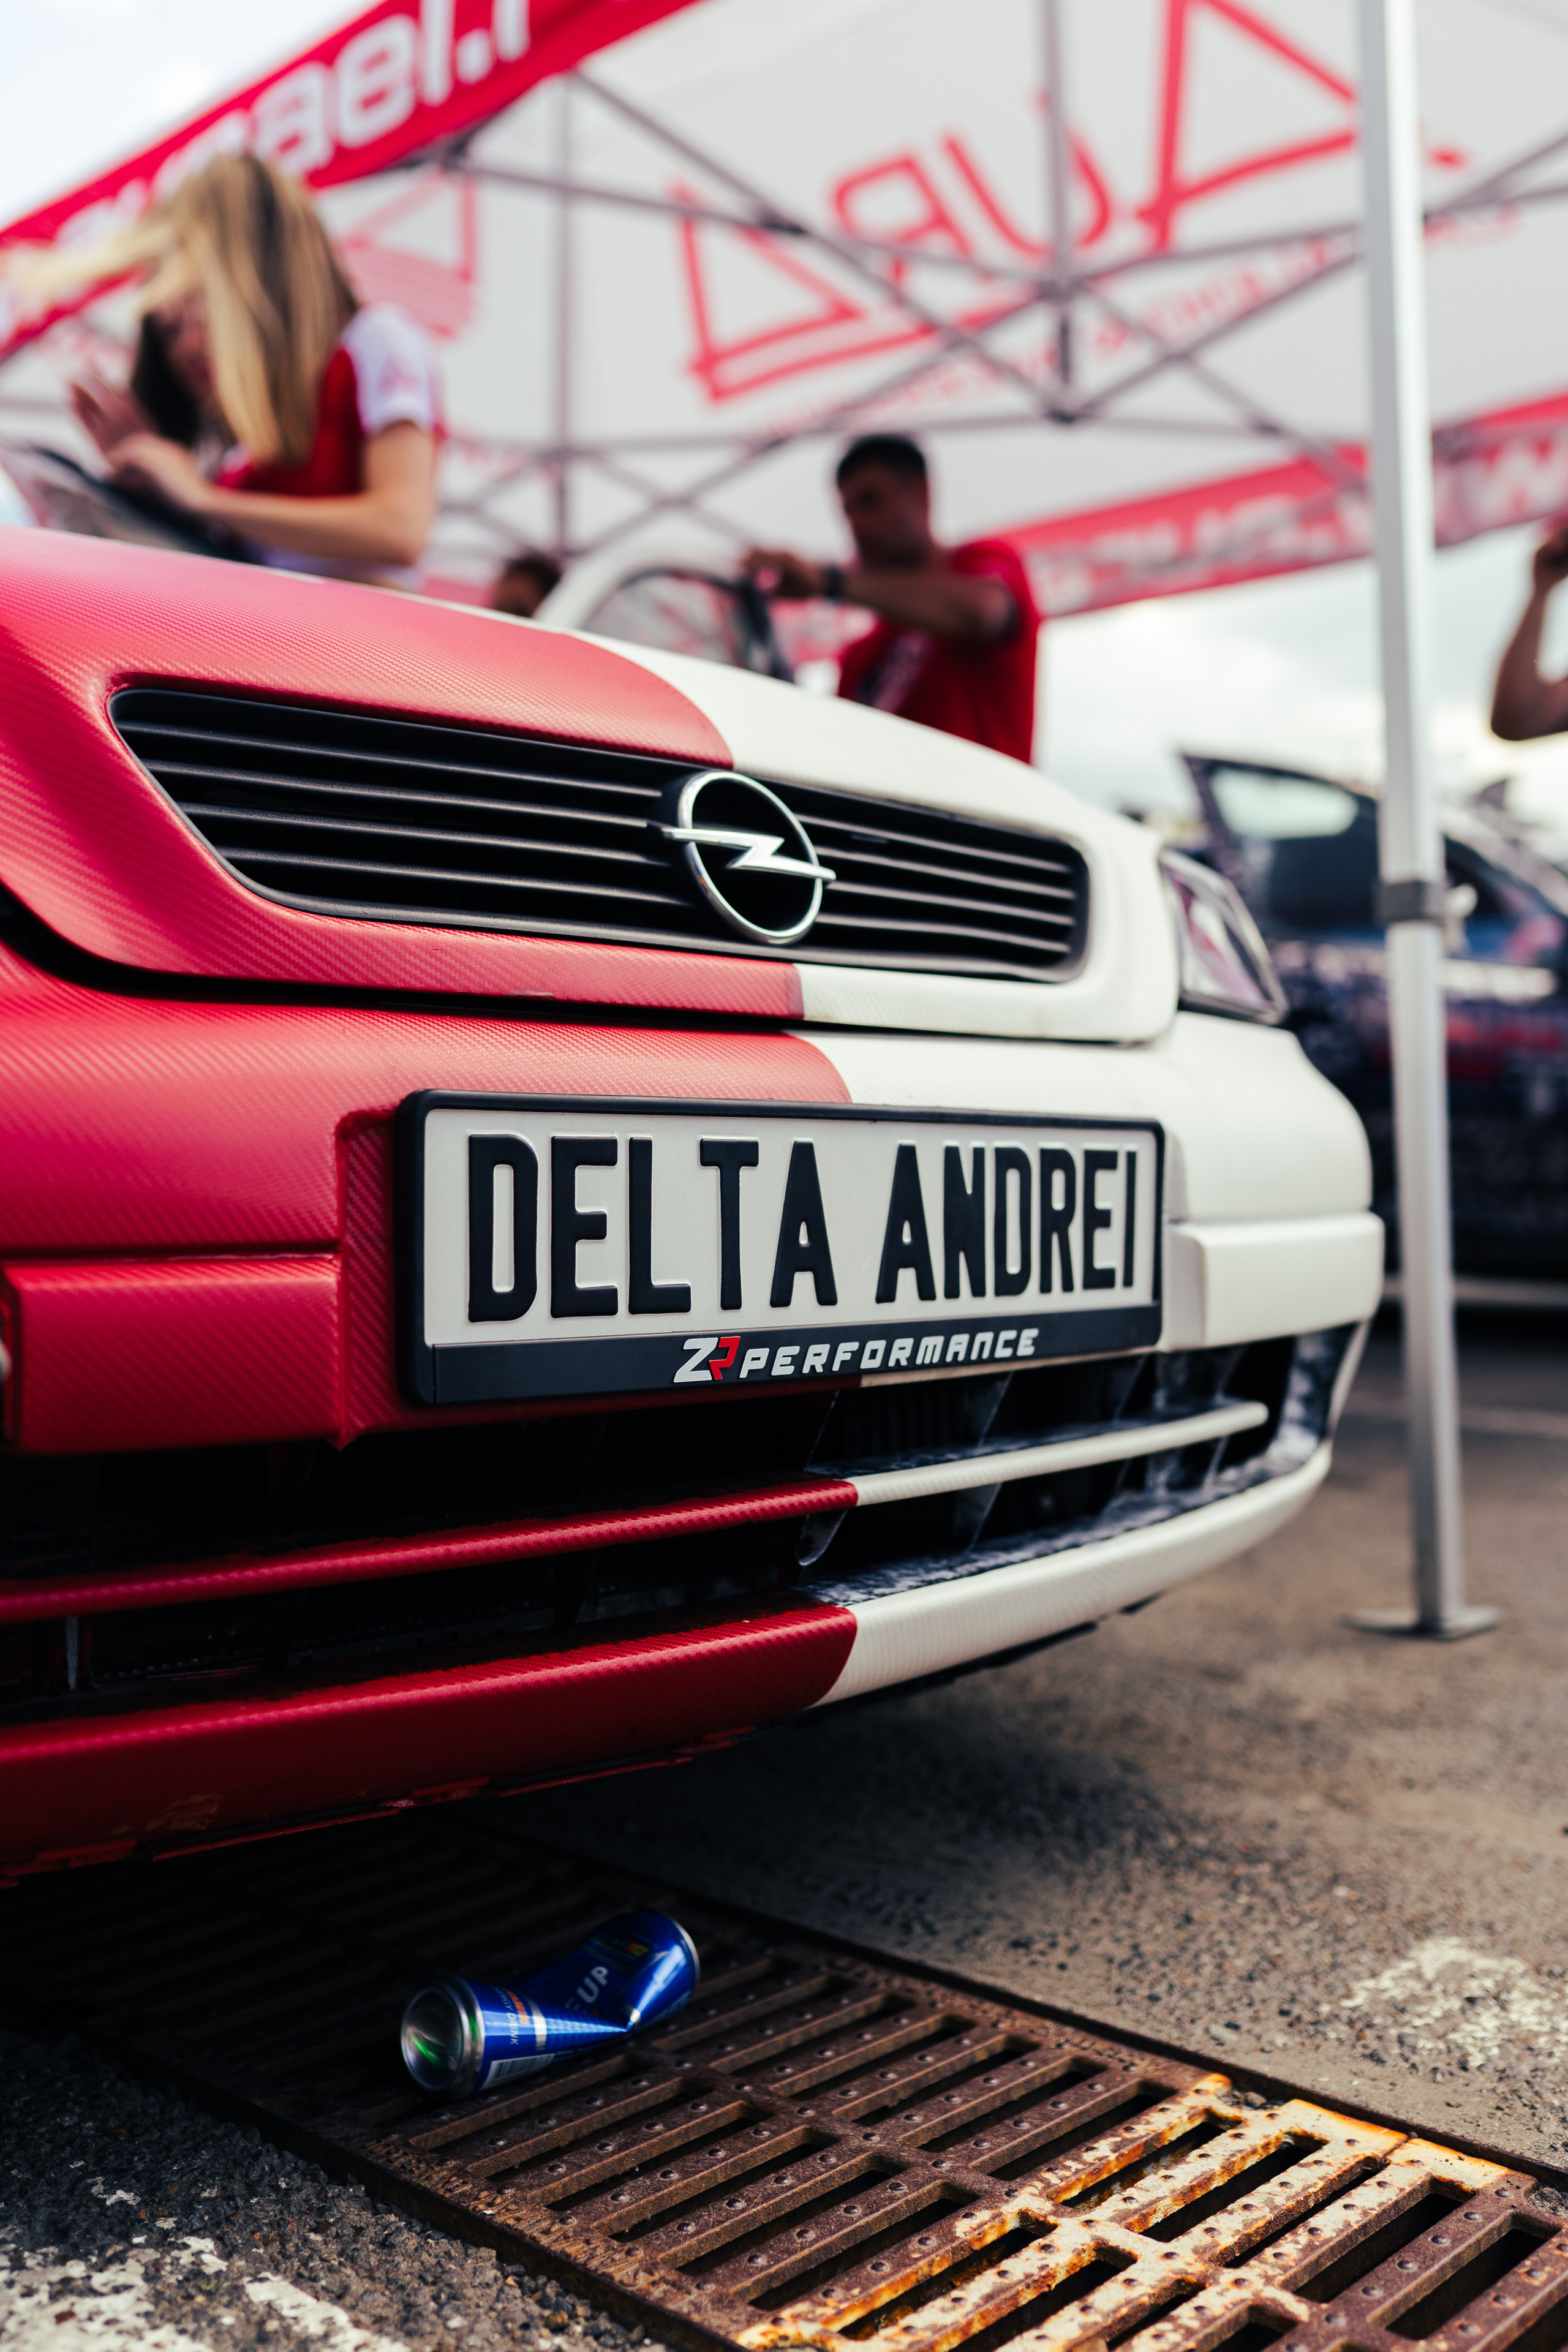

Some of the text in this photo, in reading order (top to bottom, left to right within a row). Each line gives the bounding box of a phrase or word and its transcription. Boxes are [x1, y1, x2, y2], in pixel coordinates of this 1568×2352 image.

[468, 1133, 1138, 1323] DELTA ANDREI
[738, 1328, 1039, 1379] PERFORMANCE
[576, 1966, 609, 2003] UP
[505, 2012, 519, 2045] DRINK
